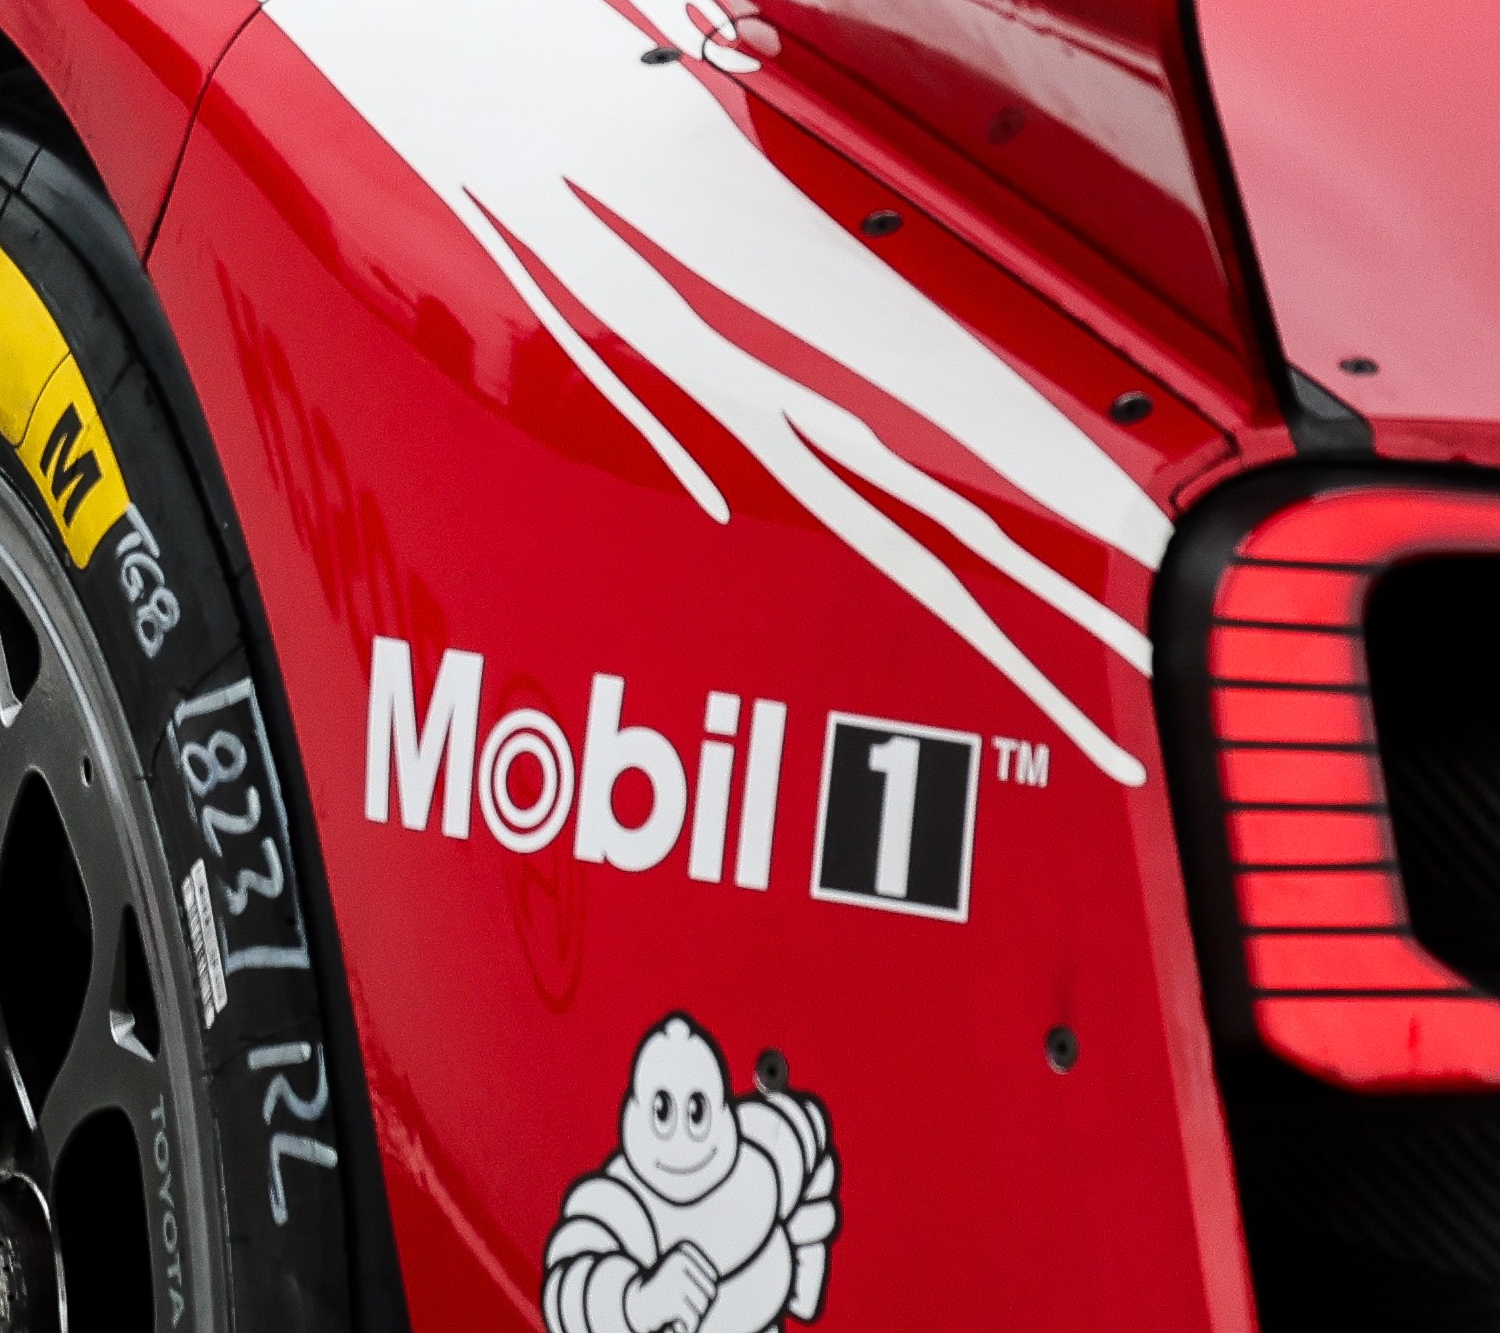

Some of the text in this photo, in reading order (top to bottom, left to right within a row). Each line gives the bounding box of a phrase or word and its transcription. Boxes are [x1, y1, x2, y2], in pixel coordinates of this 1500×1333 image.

[37, 401, 104, 530] M
[363, 633, 788, 893] Mobil
[867, 733, 923, 899] 1
[150, 1092, 186, 1330] TOYOTA
